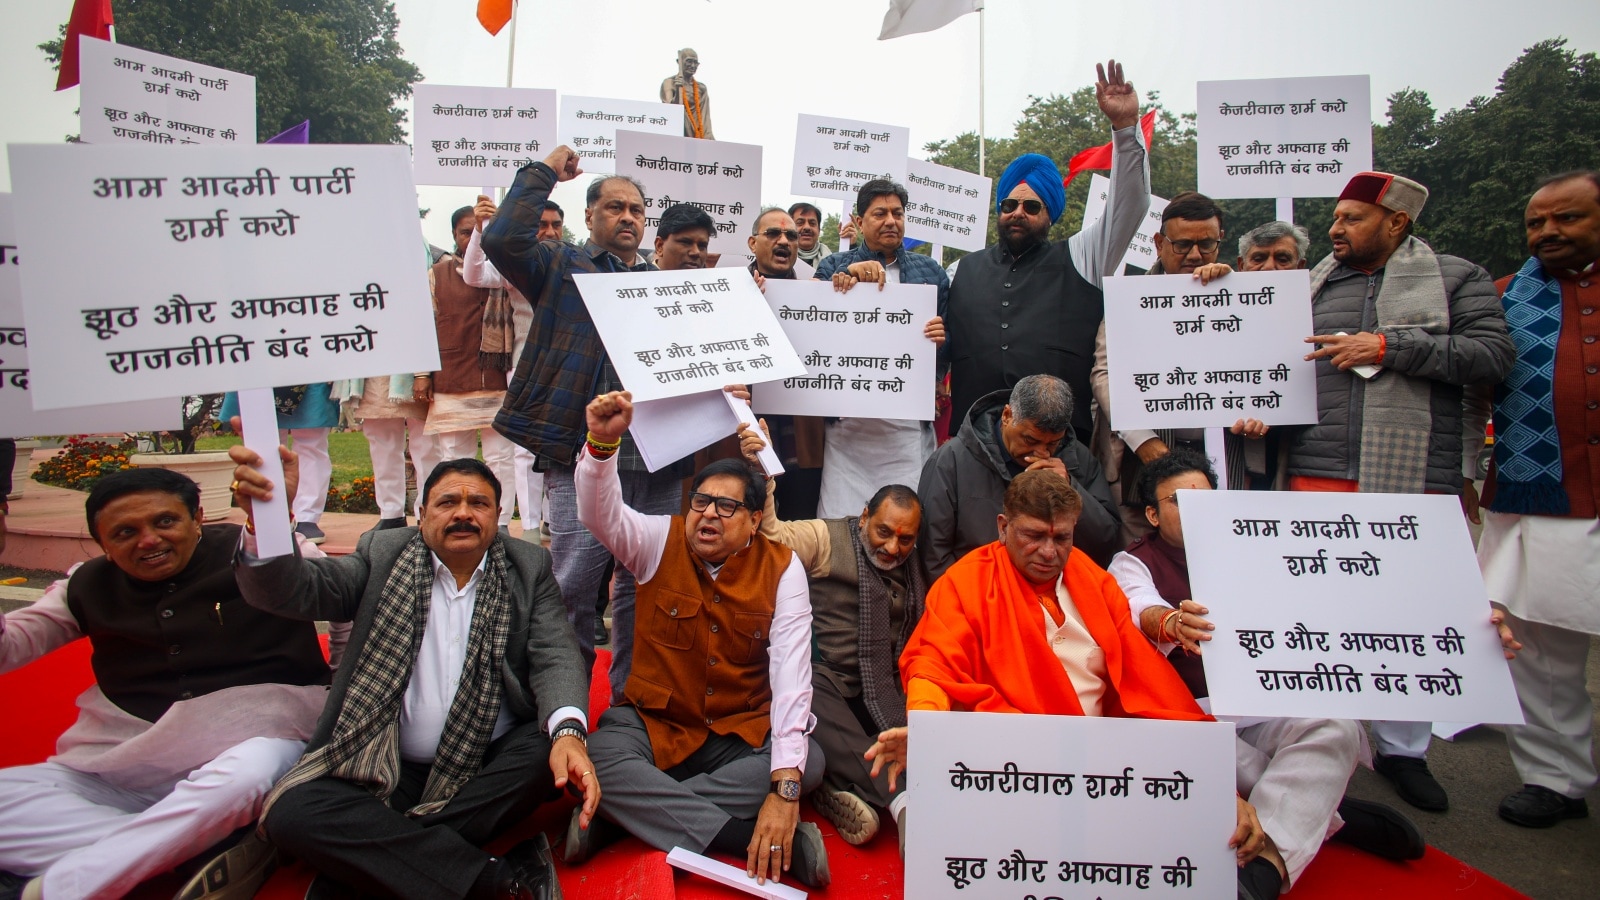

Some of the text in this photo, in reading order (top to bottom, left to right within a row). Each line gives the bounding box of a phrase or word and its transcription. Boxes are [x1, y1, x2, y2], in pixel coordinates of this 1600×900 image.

[114, 58, 228, 91] आम आदमी पार्टी
[143, 81, 202, 101] शर्म करो
[432, 104, 539, 119] केजरीवाल शर्म करो
[576, 110, 668, 125] केजरीवाल शर्म करो
[1219, 99, 1348, 116] केजरीवाल शर्म करो
[104, 108, 237, 141] झूठ और अफवाह की
[817, 127, 890, 142] आम आदमी पार्टी
[431, 138, 540, 153] झूठ और अफवाह की
[573, 136, 612, 147] झूठ और
[833, 141, 871, 153] शर्म करो
[1218, 138, 1350, 160] झूठ और अफवाह की
[438, 155, 488, 167] राजनीति
[492, 156, 509, 168] बंद
[635, 155, 744, 178] केजरीवाल शर्म करो
[807, 166, 821, 177] झूठ
[824, 166, 842, 177] और
[1226, 159, 1343, 175] राजनीति बंद करो
[93, 167, 355, 199] आम आदमी पार्टी
[810, 180, 850, 191] राजनीति
[908, 173, 979, 198] केजरीवाल शर्म करो
[729, 202, 744, 215] की
[920, 203, 935, 214] और
[937, 209, 964, 223] अफवाह
[967, 214, 977, 224] की
[165, 209, 300, 242] शर्म करो
[907, 215, 971, 235] राजनीति बंद करो
[616, 279, 730, 298] आम आदमी पार्टी
[1140, 287, 1275, 309] आम आदमी पार्टी
[81, 283, 389, 340] झूठ और अफवाह की
[654, 300, 714, 318] शर्म करो
[779, 305, 913, 324] केजरीवाल शर्म करो
[1173, 315, 1242, 335] शर्म करो
[107, 325, 378, 374] राजनीति बंद करो
[634, 333, 769, 367] झूठ और अफवाह की
[653, 354, 773, 383] राजनीति बंद करो
[804, 351, 914, 370] और अफवाह की
[783, 373, 905, 392] राजनीति बंद करो
[1133, 363, 1290, 392] झूठ और अफवाह की
[1144, 391, 1282, 412] राजनीति बंद करो
[1233, 514, 1419, 540] आम आदमी पार्टी
[1283, 549, 1381, 576] शर्म करो
[1235, 623, 1465, 658] झूठ और अफवाह की
[1256, 663, 1462, 696] राजनीति बंद करो
[949, 762, 1193, 800] केजरीवाल शर्म करो
[945, 849, 1197, 889] झूठ और अफवाह की
